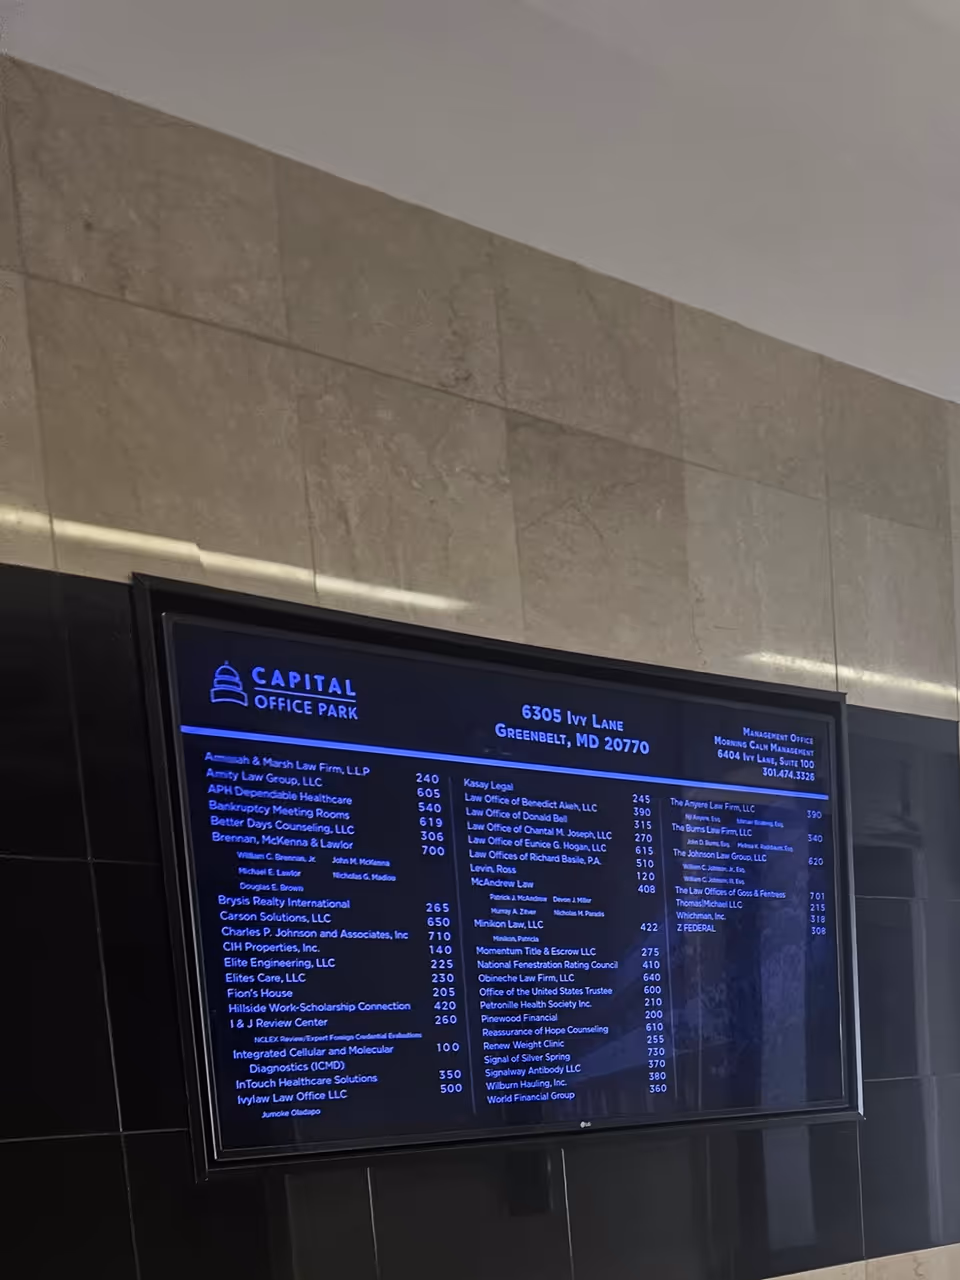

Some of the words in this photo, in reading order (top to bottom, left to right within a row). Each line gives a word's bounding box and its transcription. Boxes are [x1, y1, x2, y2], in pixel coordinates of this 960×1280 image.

[251, 666, 356, 696] CAPITAL
[254, 694, 312, 714] OFFICE
[318, 702, 357, 719] PARK
[522, 704, 561, 722] 6305
[576, 732, 599, 748] MD
[604, 736, 649, 754] 20770
[717, 749, 740, 759] 6404
[800, 759, 814, 768] 100
[241, 770, 263, 781] Law
[265, 773, 300, 786] Group,
[302, 776, 322, 787] LLC
[416, 772, 439, 783] 240
[417, 787, 440, 798] 605
[632, 793, 650, 803] 245
[208, 799, 270, 815] Bankruptcy
[272, 805, 314, 818] Meeting
[315, 808, 350, 819] Rooms
[418, 801, 441, 812] 540
[210, 815, 244, 826] Better
[246, 817, 272, 830] Days
[274, 819, 333, 834] Counseling,
[335, 824, 354, 834] LLC
[419, 816, 442, 827] 619
[420, 830, 443, 841] 306
[467, 835, 486, 844] Law
[487, 836, 513, 846] Office
[513, 838, 523, 846] of
[524, 838, 551, 848] Eunice
[552, 840, 561, 849] G.
[563, 841, 590, 851] Hogan,
[591, 844, 606, 852] LLC
[421, 845, 444, 855] 700
[635, 845, 653, 855] 615
[637, 871, 654, 880] 120
[218, 894, 250, 906] Brysis
[252, 895, 285, 908] Realty
[287, 897, 350, 908] International
[426, 902, 449, 912] 265
[219, 910, 257, 921] Carson
[259, 911, 309, 923] Solutions,
[311, 913, 331, 923] LLC
[427, 917, 450, 926] 650
[221, 926, 261, 936] Charles
[263, 927, 272, 936] P.
[275, 927, 317, 937] Johnson
[319, 929, 338, 938] and
[340, 929, 392, 939] Associates,
[394, 930, 408, 939] Inc
[428, 931, 451, 940] 710
[222, 941, 242, 951] CIH
[244, 941, 300, 952] Properties,
[302, 943, 320, 952] Inc.
[429, 945, 452, 954] 140
[476, 946, 522, 955] Momentum
[524, 946, 542, 955] Title
[543, 947, 549, 955] &
[550, 947, 579, 955] Escrow
[580, 947, 596, 955] LLC
[641, 947, 659, 956] 275
[224, 957, 248, 967] Elite
[250, 957, 313, 969] Engineering,
[316, 958, 335, 967] LLC
[430, 959, 453, 968] 225
[225, 972, 255, 982] Elites
[257, 973, 284, 983] Care,
[285, 973, 306, 982] LLC
[431, 973, 454, 982] 230
[227, 988, 258, 997] Fion's
[260, 988, 293, 997] House
[432, 987, 455, 997] 205
[479, 987, 504, 996] Office
[505, 987, 514, 995] of
[531, 987, 558, 995] United
[559, 986, 583, 995] States
[584, 986, 612, 994] Trustee
[644, 985, 661, 994] 600
[228, 1003, 266, 1012] Hillside
[268, 1002, 356, 1012] Work-Scholarship
[357, 1001, 411, 1010] Connection
[434, 1000, 456, 1010] 420
[435, 1014, 457, 1024] 260
[481, 1014, 521, 1022] Pinewood
[523, 1013, 557, 1021] Financial
[645, 1010, 662, 1018] 200
[230, 1019, 234, 1028] I
[236, 1019, 244, 1028] &
[247, 1019, 253, 1028] J
[256, 1018, 292, 1027] Review
[294, 1017, 328, 1027] Center
[437, 1042, 459, 1051] 100
[233, 1048, 286, 1060] Integrated
[289, 1047, 326, 1057] Cellular
[328, 1046, 346, 1055] and
[348, 1045, 393, 1054] Molecular
[249, 1062, 308, 1074] Diagnostics
[310, 1060, 345, 1071] (ICMD)
[648, 1059, 665, 1068] 370
[439, 1069, 461, 1079] 350
[484, 1068, 526, 1078] Signalway
[527, 1065, 564, 1074] Antibody
[565, 1064, 580, 1072] LLC
[236, 1078, 276, 1089] InTouch
[278, 1077, 332, 1086] Healthcare
[333, 1075, 378, 1084] Solutions
[440, 1083, 462, 1093] 500
[649, 1083, 666, 1093] 360
[237, 1094, 270, 1105] Ivylaw
[272, 1093, 293, 1102] Law
[296, 1091, 326, 1101] Office
[328, 1089, 347, 1099] LLC
[486, 1094, 512, 1103] World
[513, 1092, 548, 1101] Financial
[550, 1091, 575, 1100] Group
